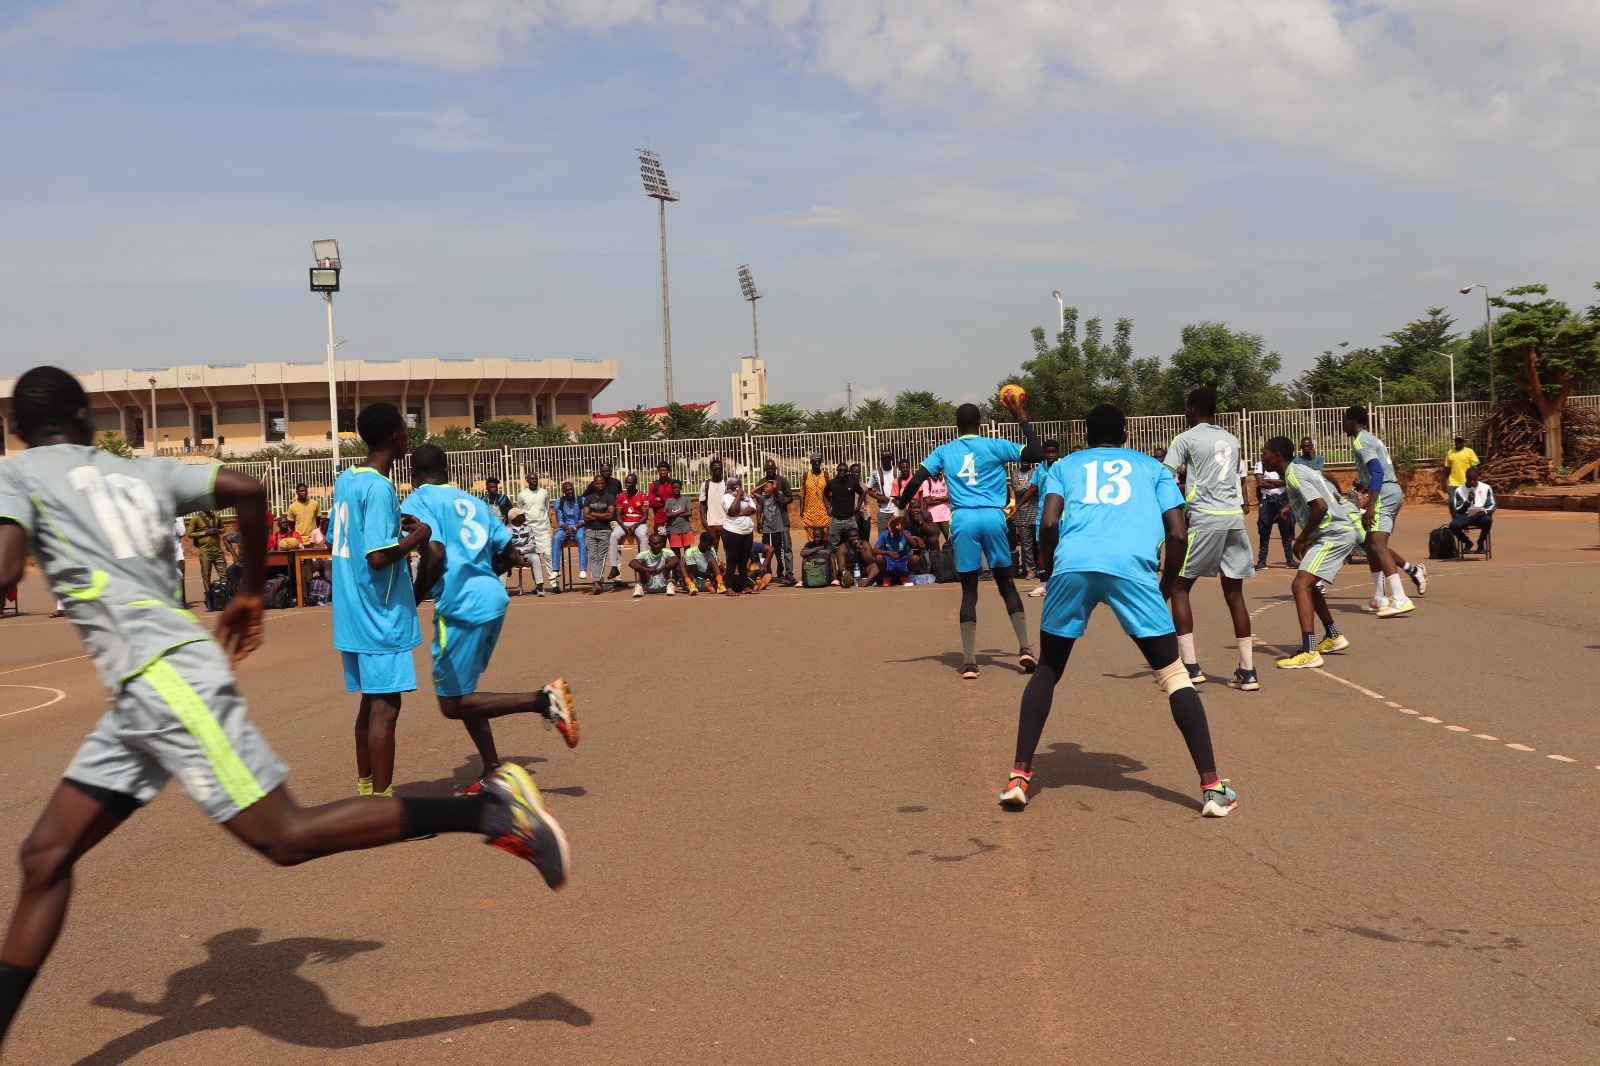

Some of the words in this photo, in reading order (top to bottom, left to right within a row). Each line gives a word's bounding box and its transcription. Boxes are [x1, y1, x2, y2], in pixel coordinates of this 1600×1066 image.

[957, 452, 978, 485] 4
[1082, 459, 1132, 506] 13
[1215, 440, 1232, 481] 9
[332, 500, 350, 558] 12
[454, 498, 488, 550] 3
